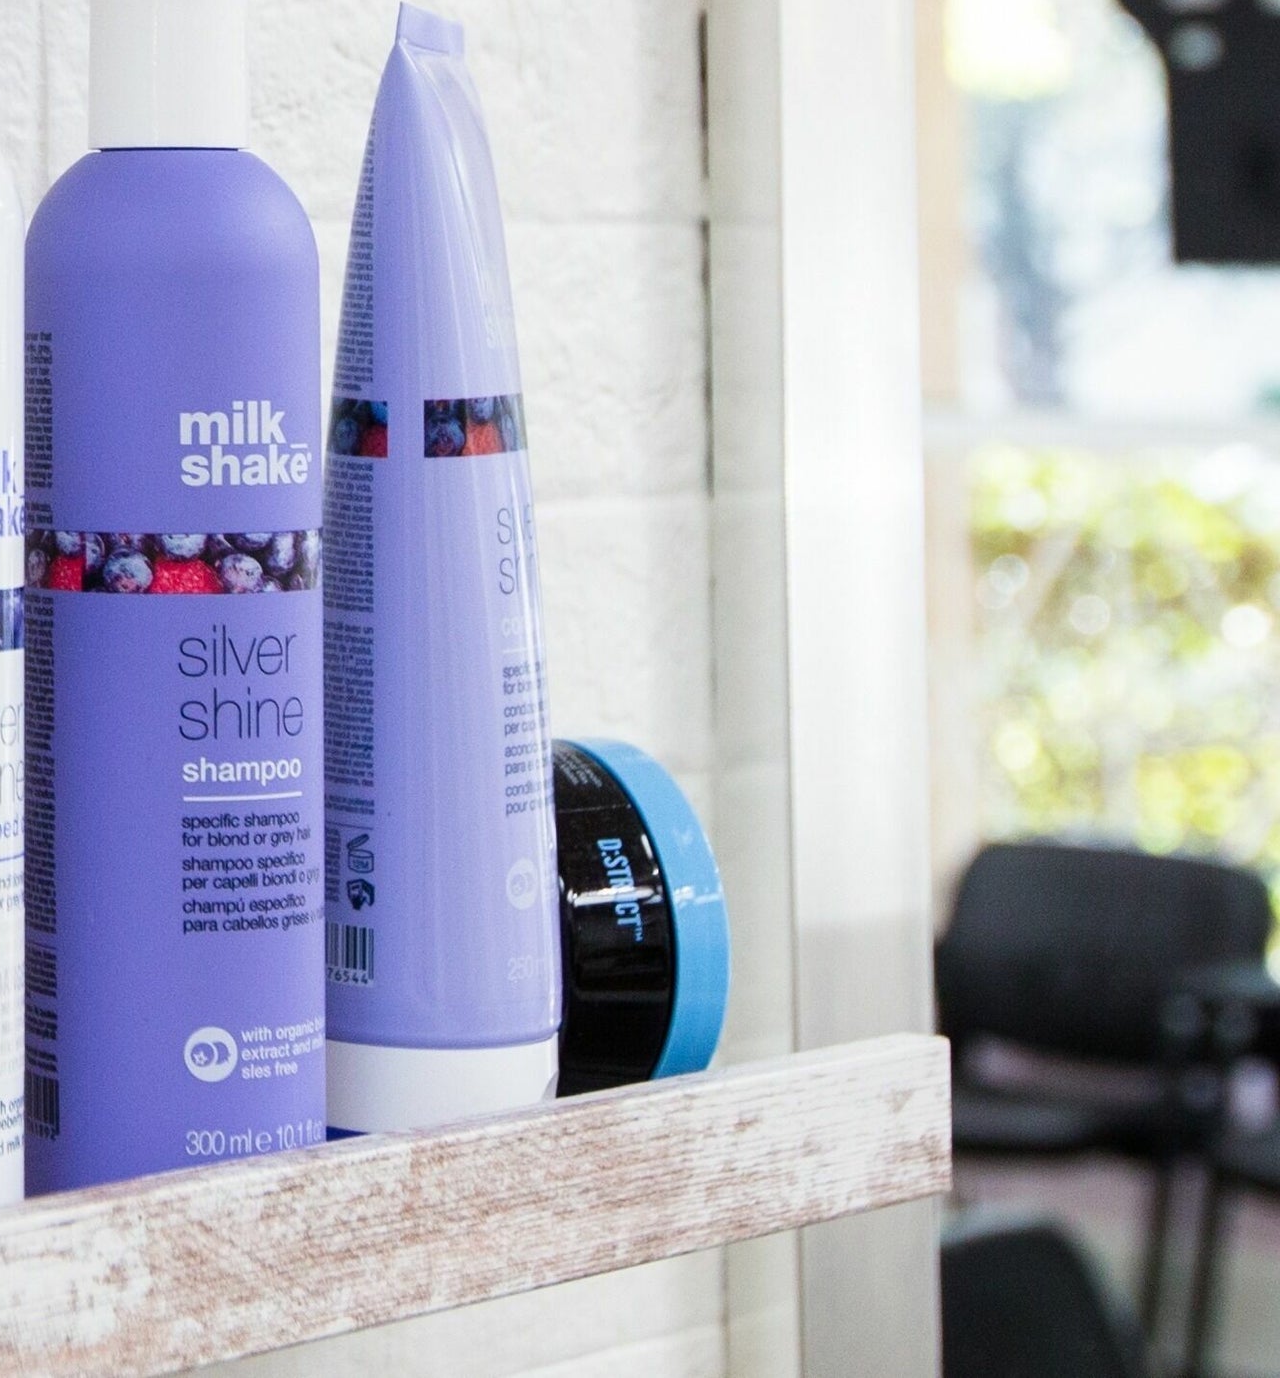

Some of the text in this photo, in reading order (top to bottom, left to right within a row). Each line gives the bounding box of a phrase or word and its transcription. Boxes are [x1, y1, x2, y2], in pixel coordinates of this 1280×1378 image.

[180, 443, 308, 487] shake
[178, 624, 297, 678] silver
[178, 686, 303, 741] shine
[182, 756, 302, 787] shampoo
[181, 811, 300, 832] specific shampoo
[181, 830, 203, 847] for
[207, 830, 250, 847] blond
[253, 832, 267, 846] or
[270, 829, 294, 848] grey
[181, 855, 254, 873] shampoo
[182, 875, 208, 892] per
[212, 872, 259, 891] capelli
[182, 897, 246, 915] champú
[182, 918, 219, 935] para
[222, 914, 279, 932] cabellos
[241, 1025, 272, 1043] with
[241, 1040, 311, 1062] extract and
[241, 1060, 299, 1080] sles free
[185, 1129, 226, 1156] 300
[229, 1128, 252, 1155] ml
[276, 1124, 303, 1151] 10.1
